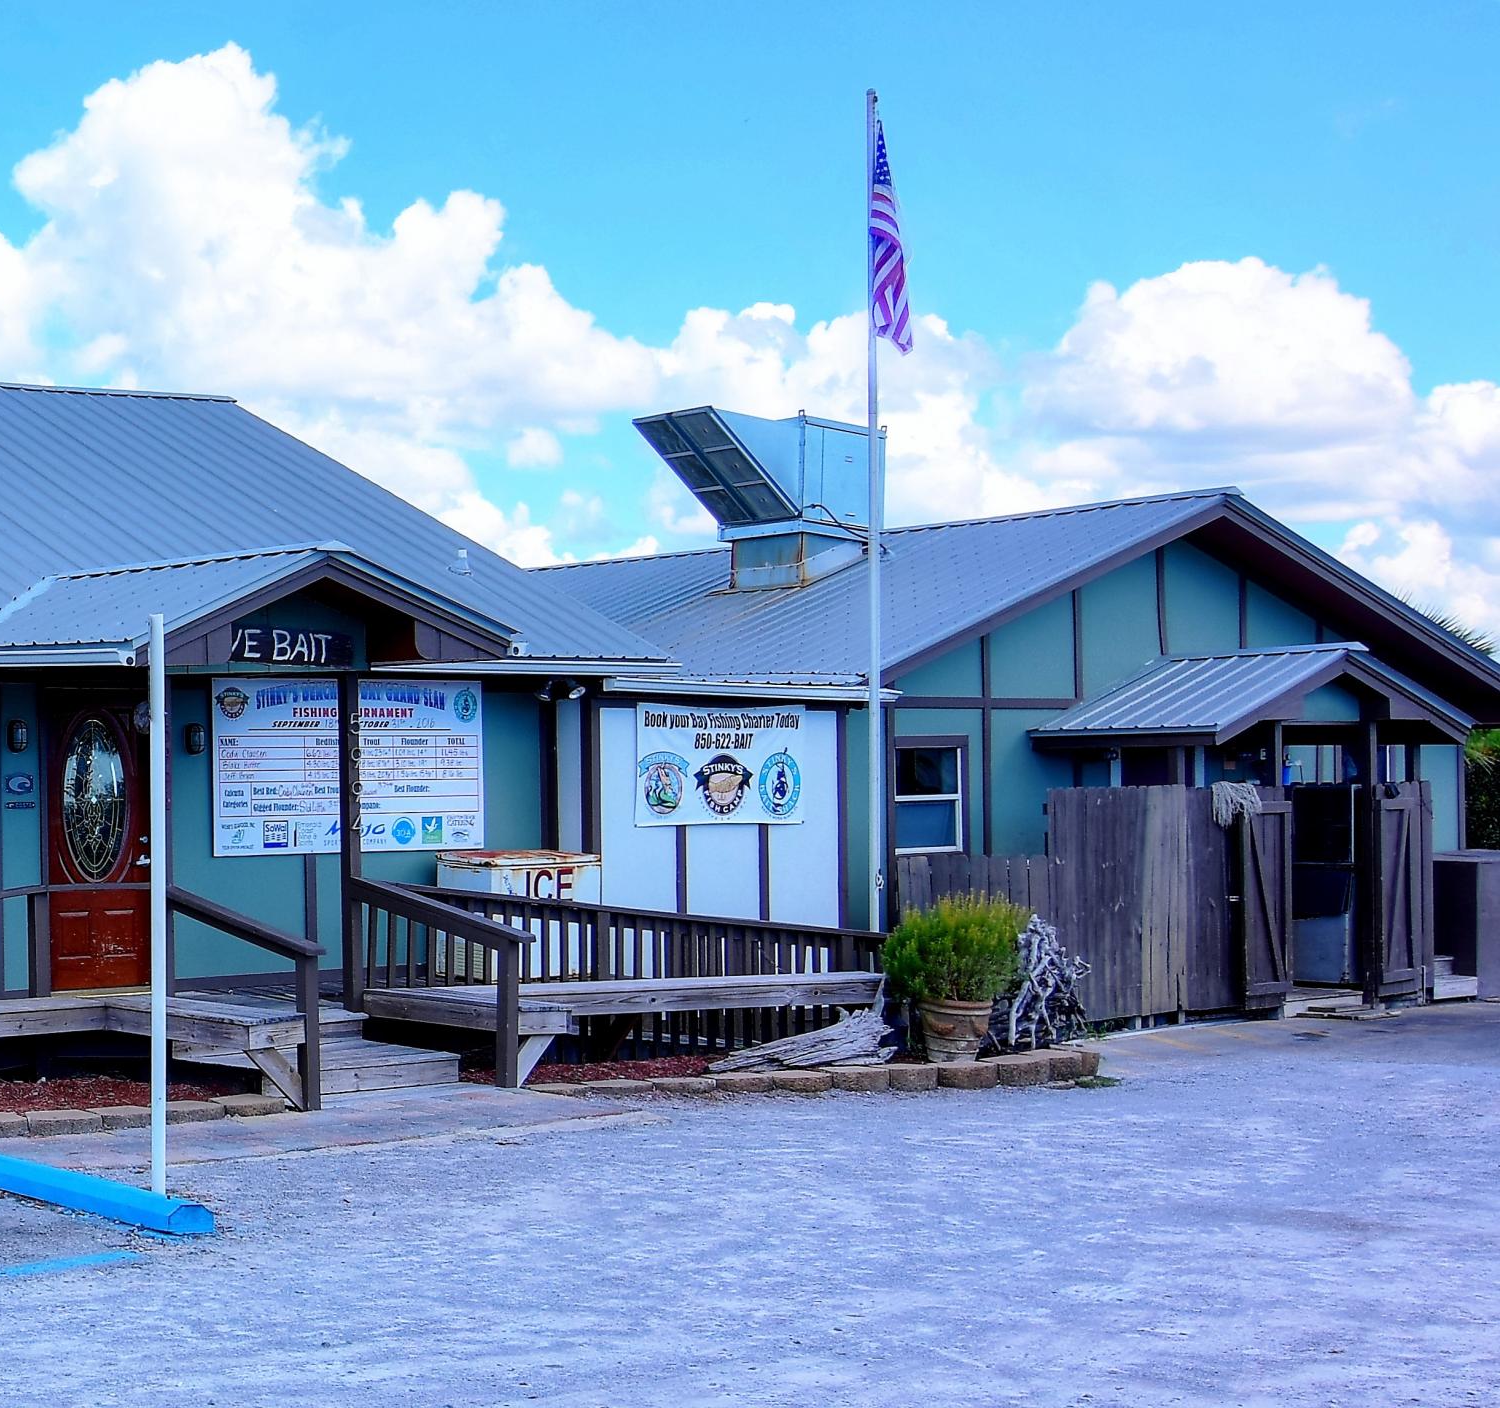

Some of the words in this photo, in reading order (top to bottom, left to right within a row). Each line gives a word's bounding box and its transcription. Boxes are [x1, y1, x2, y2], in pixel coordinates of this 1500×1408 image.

[272, 629, 333, 664] BAIT
[423, 687, 445, 711] SLAM
[292, 707, 337, 718] FISHING
[359, 708, 414, 719] URNAMENT
[271, 720, 321, 728] SEPTEMBER
[644, 710, 668, 728] Book
[669, 713, 690, 729] your
[692, 712, 708, 730] Bay
[709, 712, 741, 731] Fishing
[742, 712, 775, 730] Charter
[776, 712, 800, 730] Today
[219, 738, 239, 747] NAME:
[363, 738, 380, 746] Trout
[401, 737, 429, 746] Flounder
[446, 737, 465, 745] TOTAL
[694, 733, 754, 750] 850-622-BAIT
[702, 762, 744, 775] STINKY'S
[327, 786, 340, 794] Trou
[265, 823, 287, 832] SoWal
[526, 868, 574, 901] ICE
